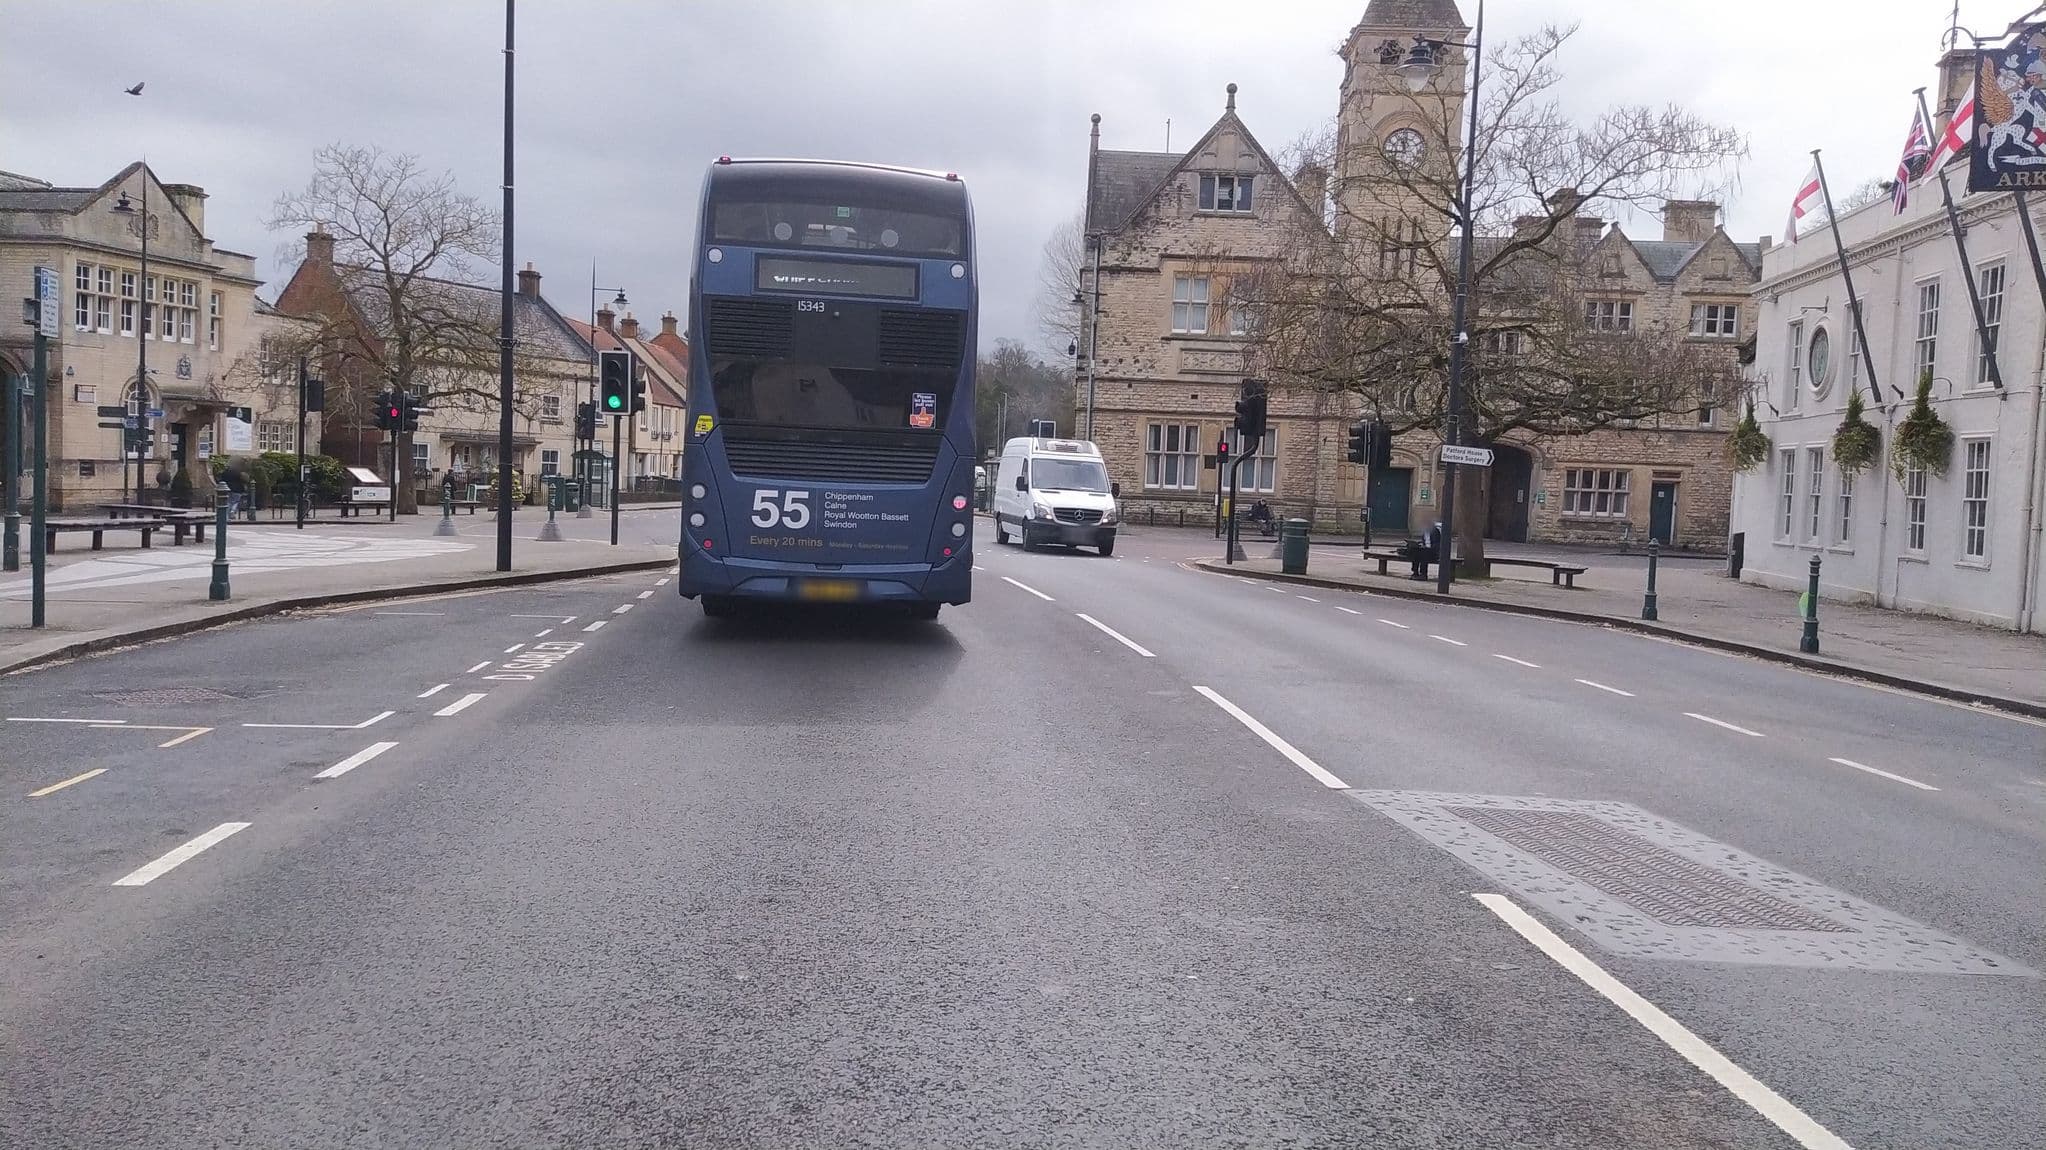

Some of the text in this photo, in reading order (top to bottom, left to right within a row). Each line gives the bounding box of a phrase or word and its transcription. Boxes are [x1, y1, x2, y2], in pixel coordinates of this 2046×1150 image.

[798, 300, 825, 312] 15343
[1465, 455, 1485, 464] Surgery
[824, 491, 874, 501] Chippenham
[751, 489, 810, 529] 55
[824, 501, 847, 510] Calne
[824, 510, 909, 521] Royal Wootton Bassett
[823, 520, 857, 529] Swindon
[750, 535, 823, 547] Every 20 mins
[481, 641, 585, 680] DISABLED
